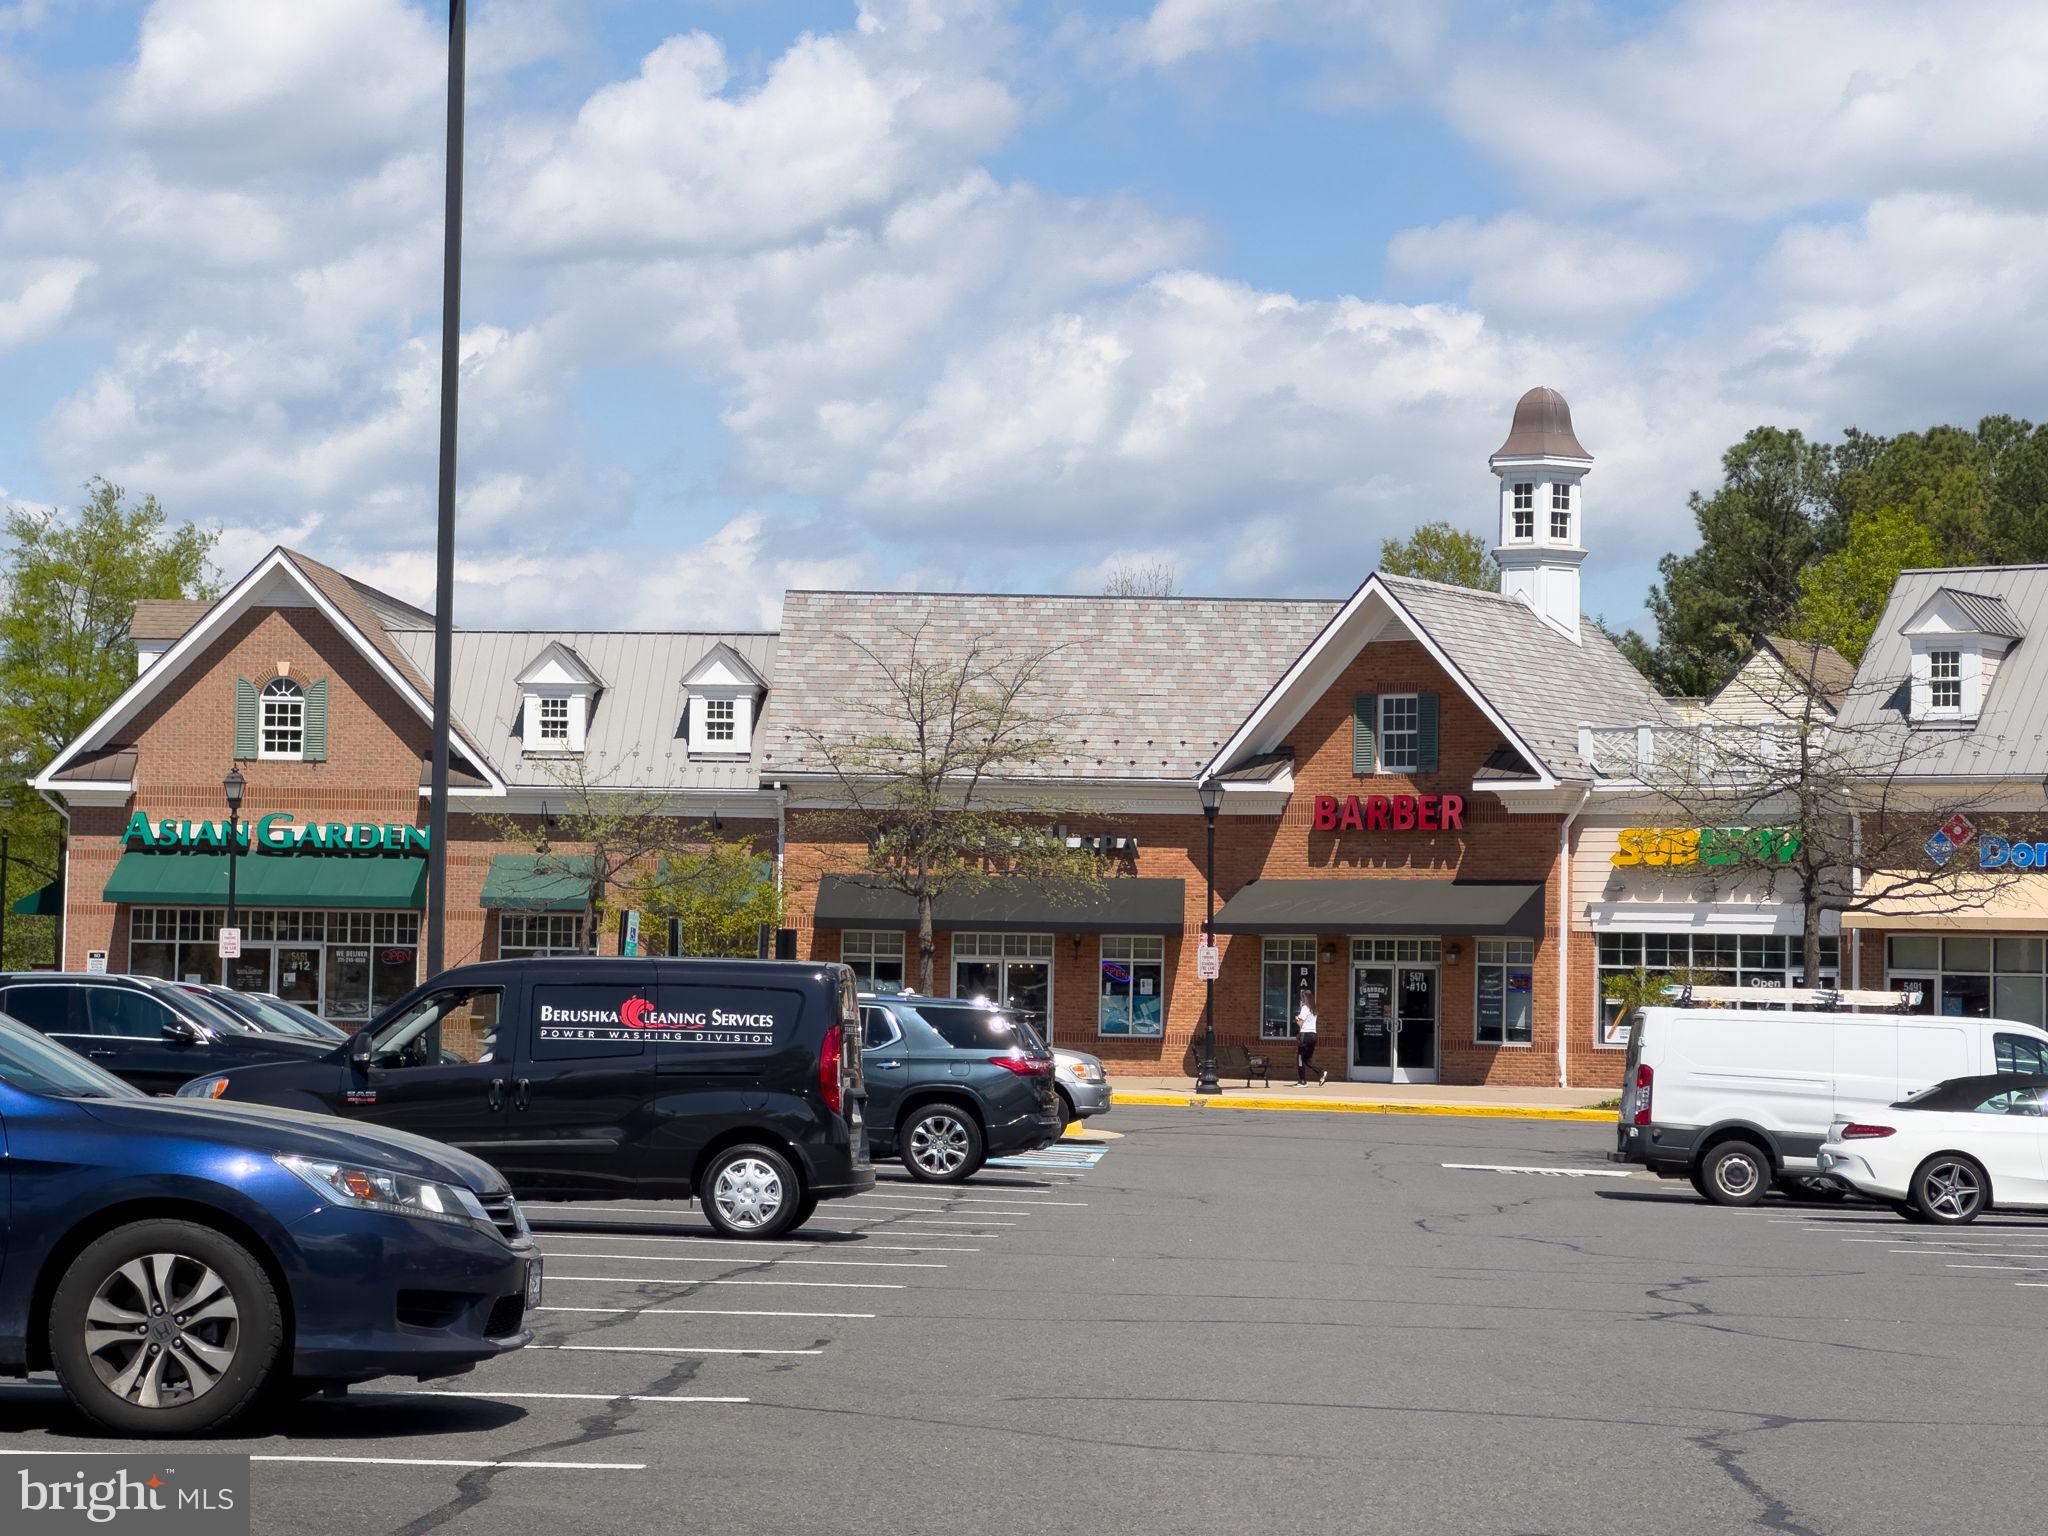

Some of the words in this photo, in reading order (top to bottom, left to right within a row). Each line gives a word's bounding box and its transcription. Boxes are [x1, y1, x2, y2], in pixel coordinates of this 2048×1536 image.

[1314, 795, 1464, 830] BARBER
[120, 811, 250, 847] ASIAN
[257, 812, 430, 850] GARDEN
[291, 961, 310, 971] #12
[1751, 977, 1781, 988] Open
[1903, 981, 1923, 992] 5491
[540, 1005, 619, 1024] BERUSHKA
[711, 1008, 774, 1028] SERVICES
[541, 1030, 595, 1039] POWER
[609, 1031, 682, 1041] WASHING
[696, 1033, 773, 1043] DIVISION
